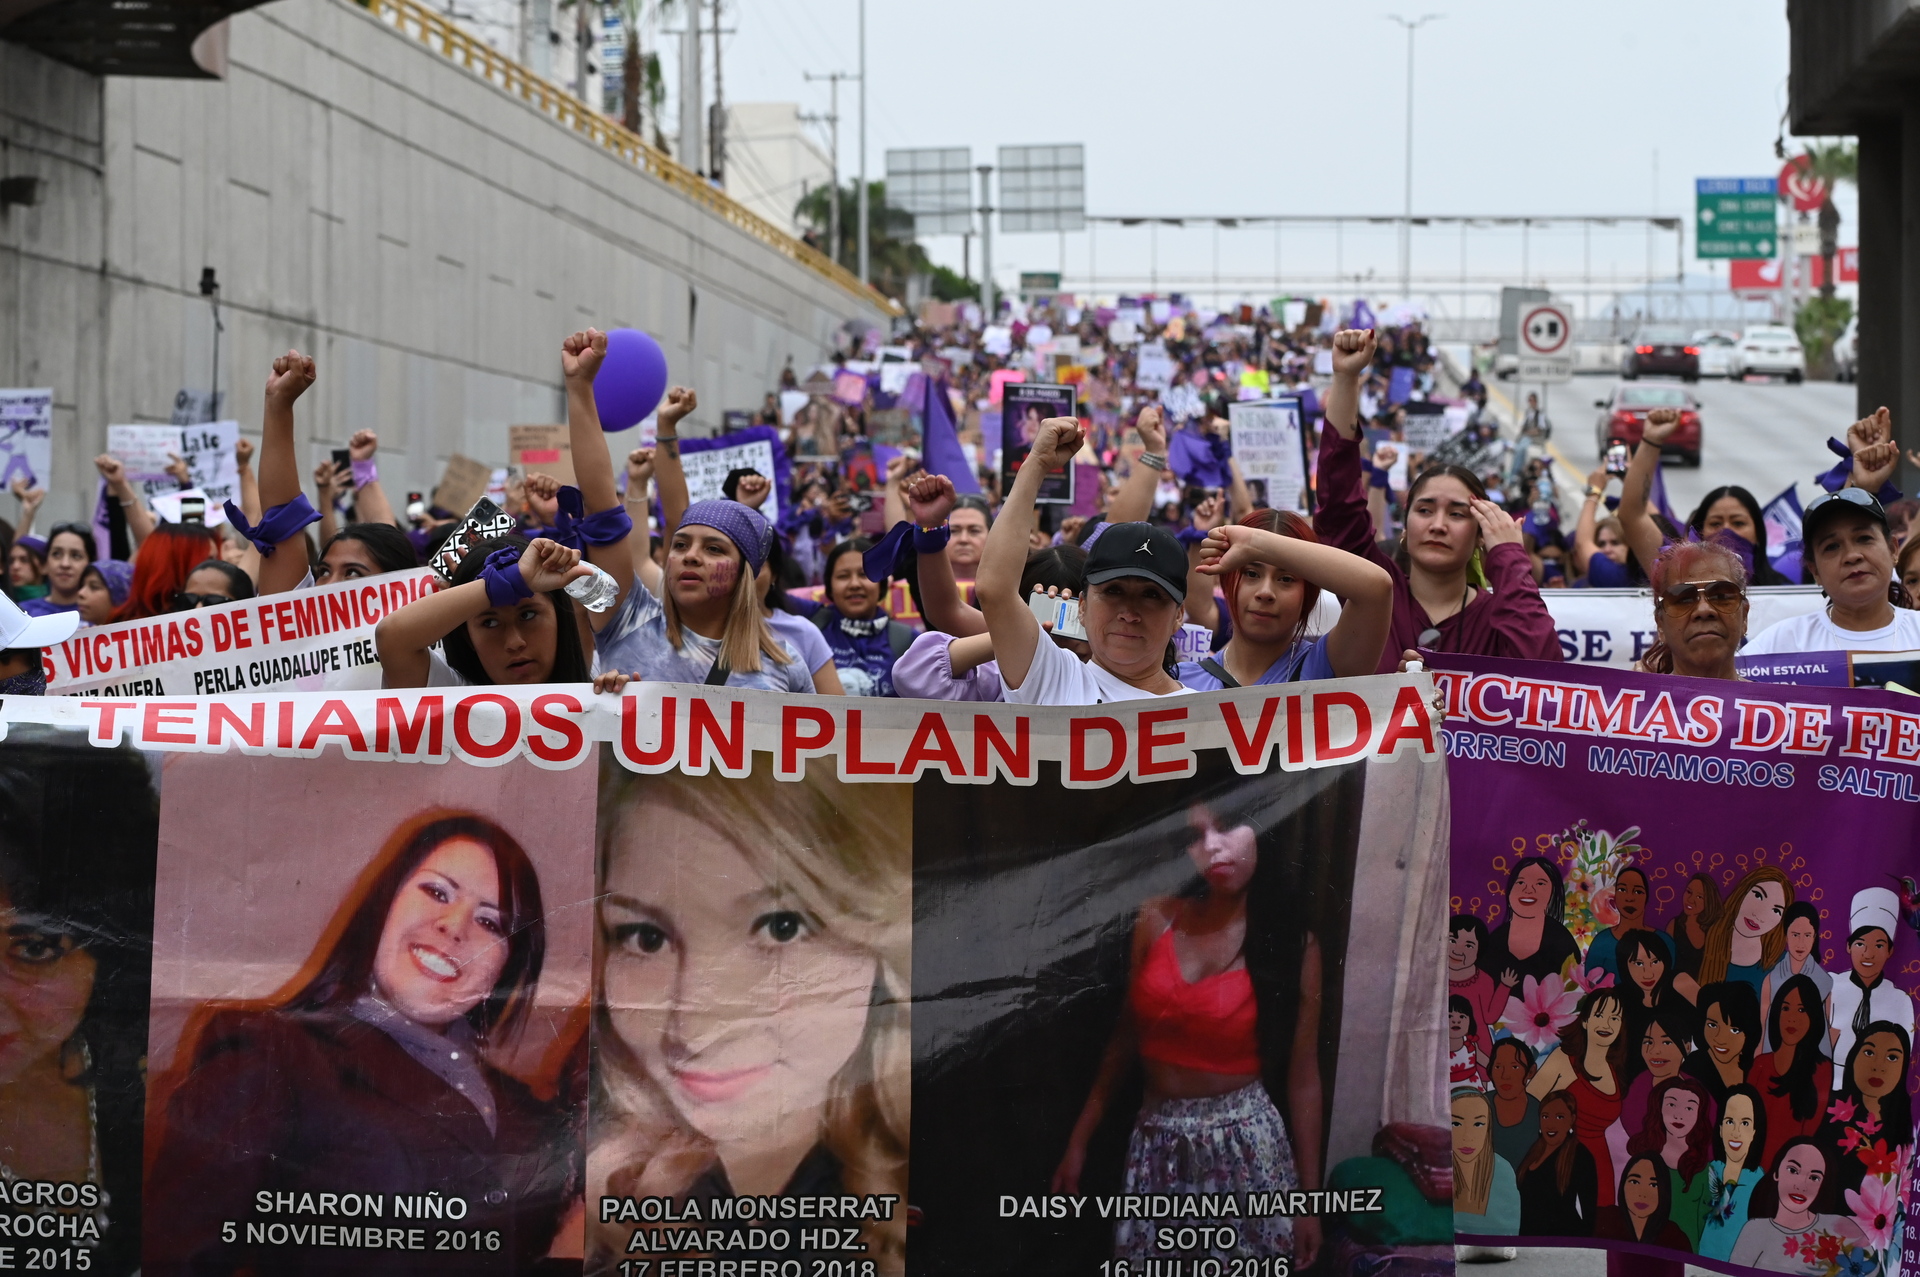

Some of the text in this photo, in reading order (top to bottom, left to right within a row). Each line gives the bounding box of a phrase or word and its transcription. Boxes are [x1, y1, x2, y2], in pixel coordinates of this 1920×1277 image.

[61, 617, 202, 681] VICTIMAS
[210, 609, 252, 652] DE
[1556, 629, 1612, 662] SE
[194, 639, 380, 695] PERLA GUADALUPE TRE
[1773, 664, 1828, 676] ESTATAL
[80, 686, 1437, 782] TENIAMOS UN PLAN DE VIDA
[1730, 698, 1833, 756] DE
[1839, 706, 1920, 766] FE
[1441, 729, 1567, 768] ORREON
[1588, 746, 1795, 788] MATAMOROS
[255, 1190, 468, 1220] SHARON NIÑO
[602, 1196, 897, 1221] PAOLA MONSERRAT
[1000, 1188, 1383, 1218] DAISY VIRIDIANA MARTINEZ
[221, 1221, 500, 1252] 5 NOVIEMBRE 2016
[628, 1228, 867, 1252] ALVARADO HDZ.
[1157, 1227, 1237, 1250] SOTO
[25, 1247, 91, 1271] 2015
[619, 1260, 875, 1277] 17 FEBRERO 2018
[1099, 1257, 1290, 1277] 16 JULIO 2016
